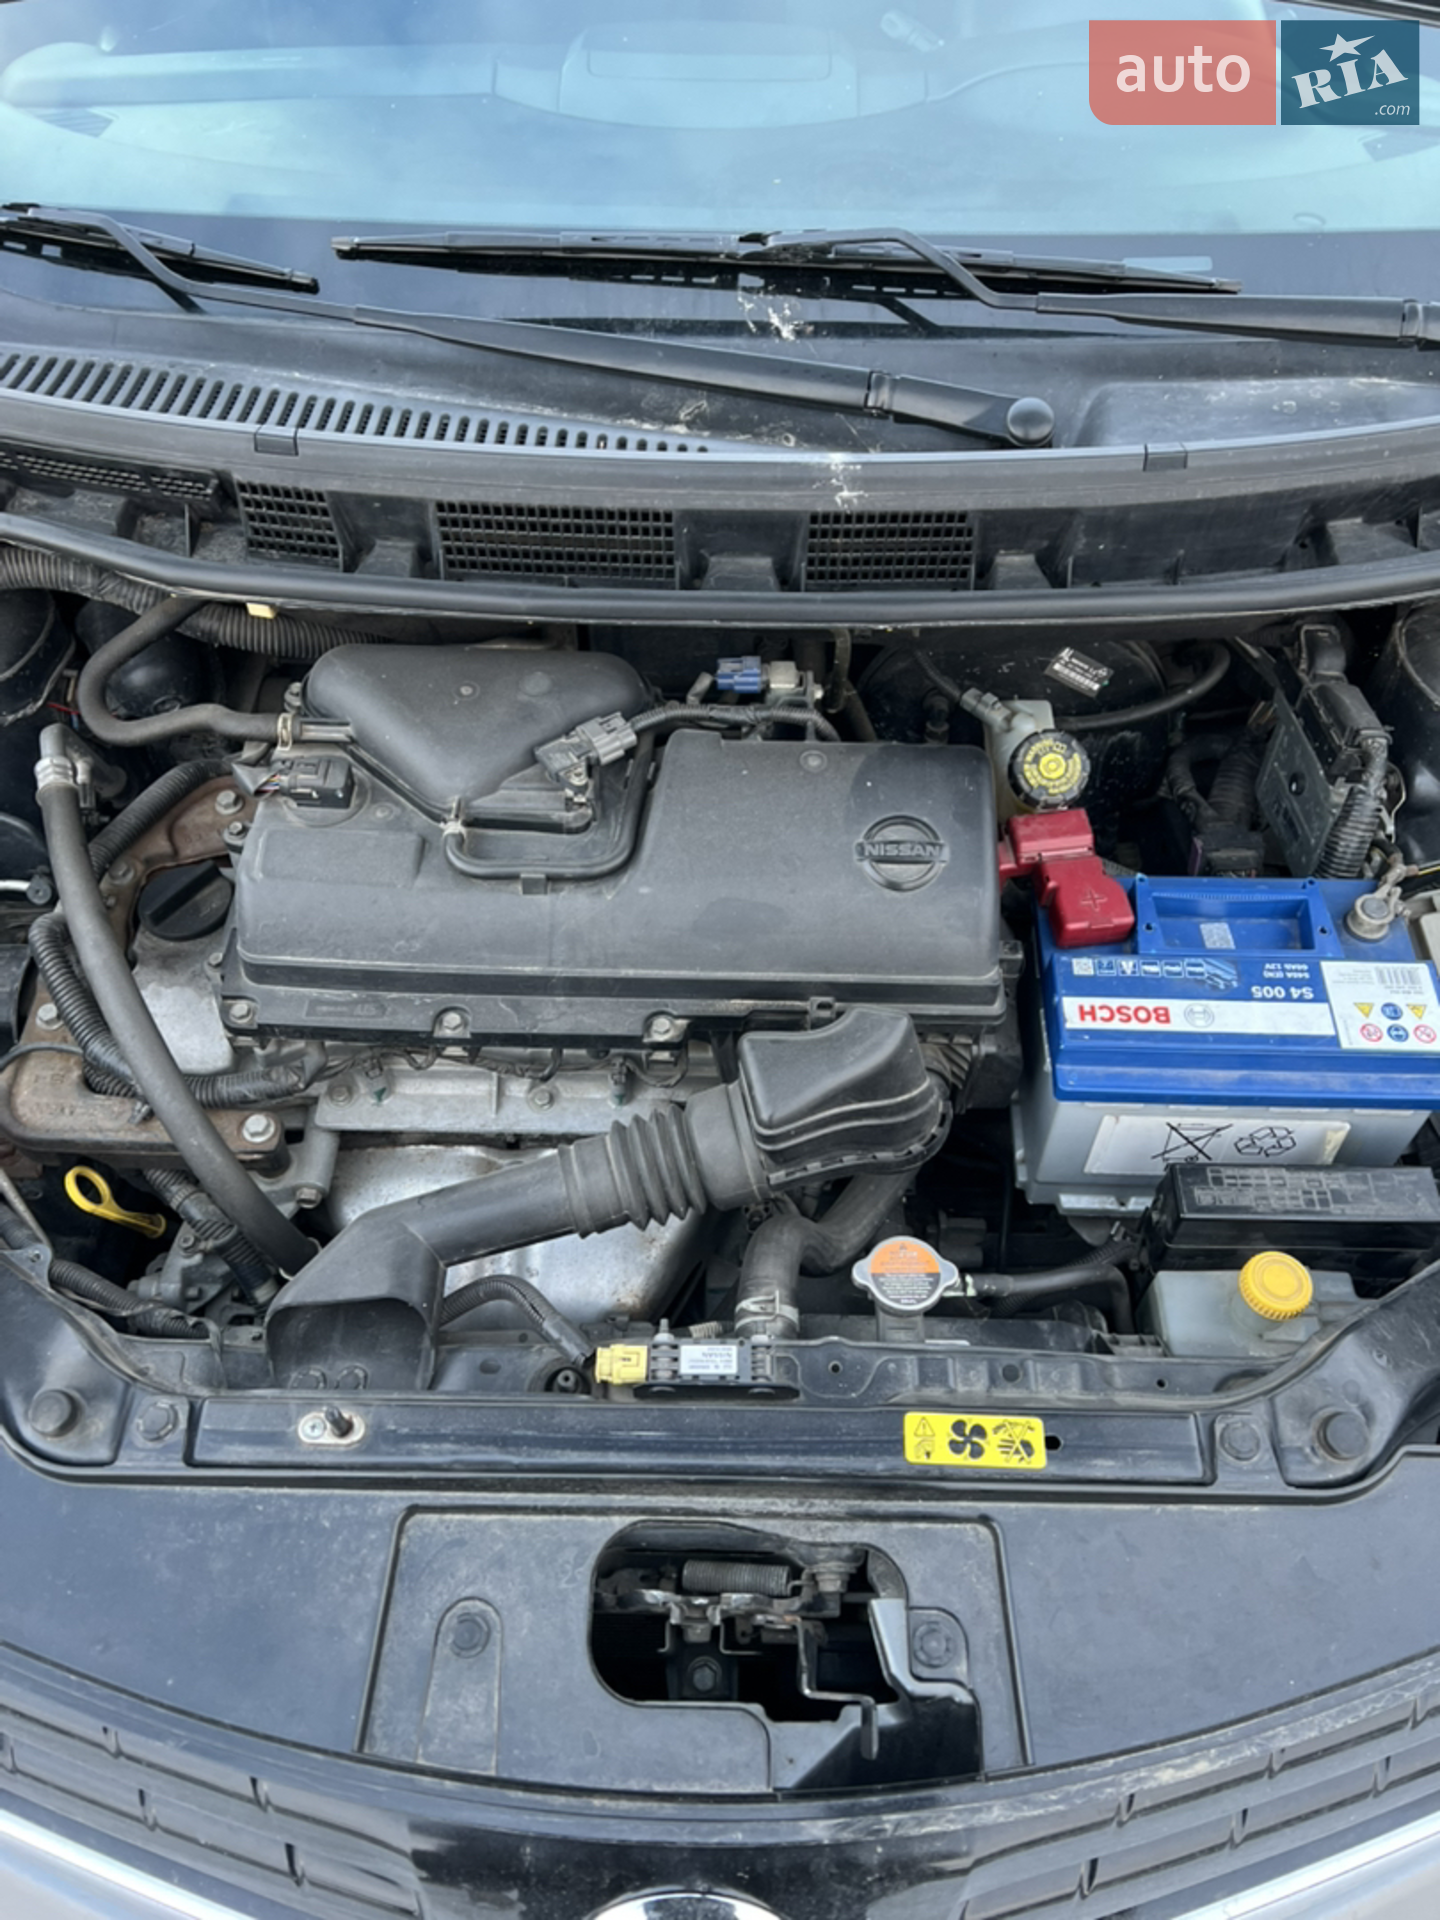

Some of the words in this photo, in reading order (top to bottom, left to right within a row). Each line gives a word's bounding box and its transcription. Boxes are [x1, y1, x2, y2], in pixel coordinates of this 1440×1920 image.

[864, 842, 940, 856] NISSAN
[1251, 985, 1285, 999] 005
[1289, 986, 1315, 999] S4
[1078, 1004, 1171, 1024] BOSCH
